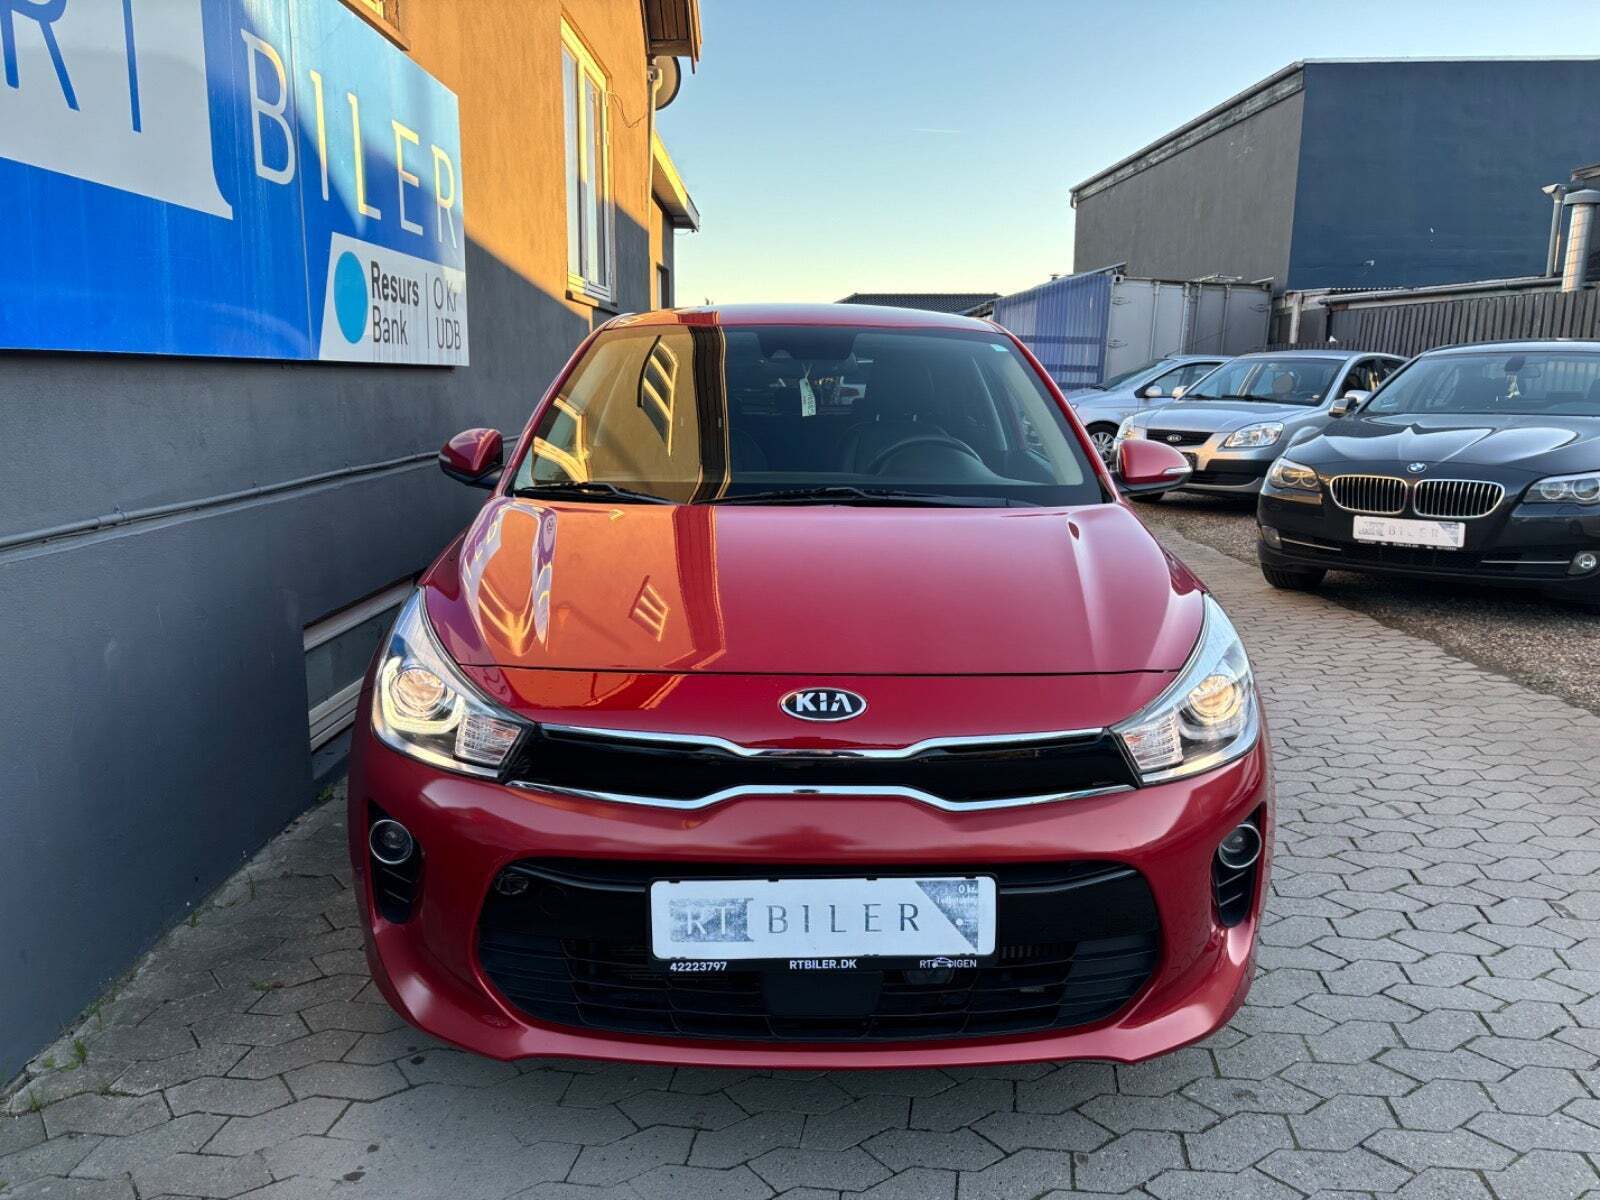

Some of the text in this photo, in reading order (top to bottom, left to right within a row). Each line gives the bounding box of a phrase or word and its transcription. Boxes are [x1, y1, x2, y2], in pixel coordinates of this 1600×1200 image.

[239, 28, 458, 248] BILER
[371, 261, 419, 307] Resurs
[372, 305, 408, 345] Bank
[436, 317, 462, 350] UDB
[795, 692, 853, 712] KIA
[766, 902, 920, 934] BILER
[670, 961, 727, 972] 42223797
[789, 958, 857, 970] RTBILER.DK
